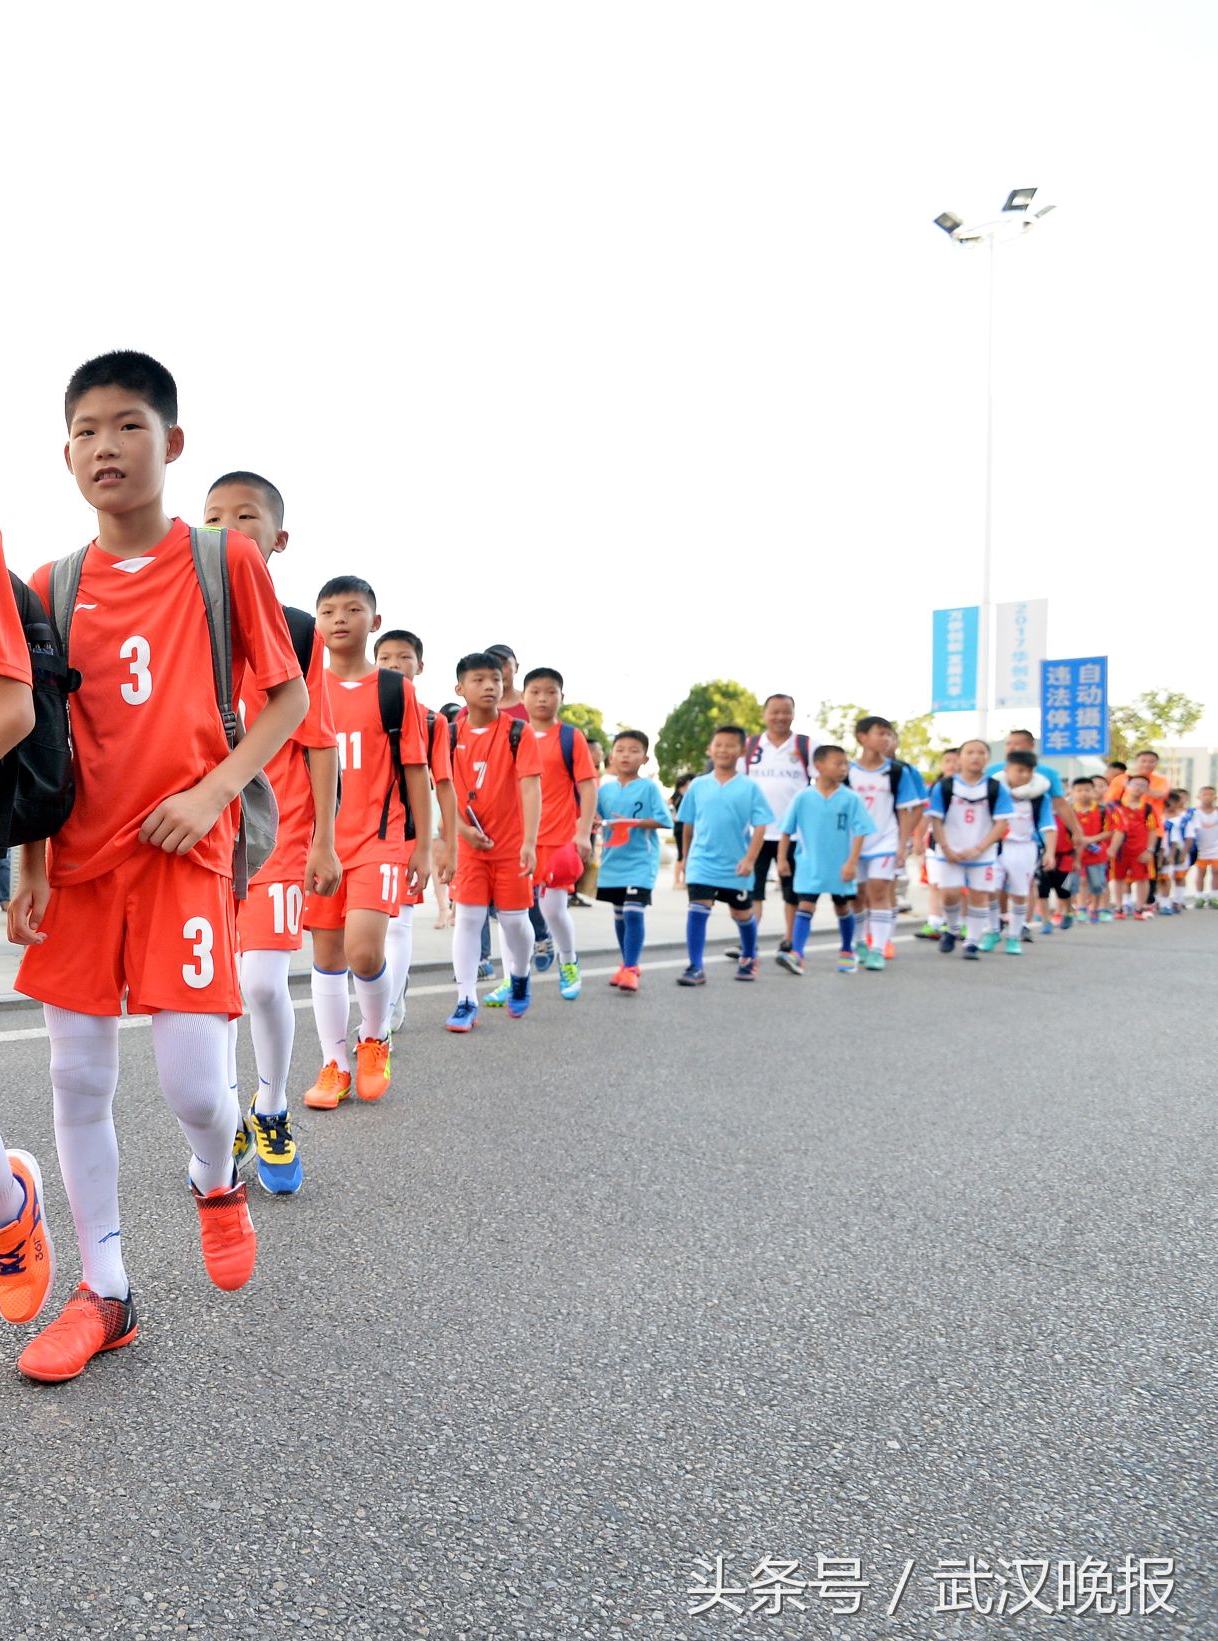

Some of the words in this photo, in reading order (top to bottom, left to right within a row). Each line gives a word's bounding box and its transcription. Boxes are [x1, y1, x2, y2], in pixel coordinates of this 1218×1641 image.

[119, 635, 152, 706] 3
[336, 731, 362, 770] 11
[473, 761, 487, 789] 7
[964, 808, 975, 824] 6
[379, 863, 398, 904] 11
[268, 882, 302, 935] 10
[181, 916, 214, 988] 3
